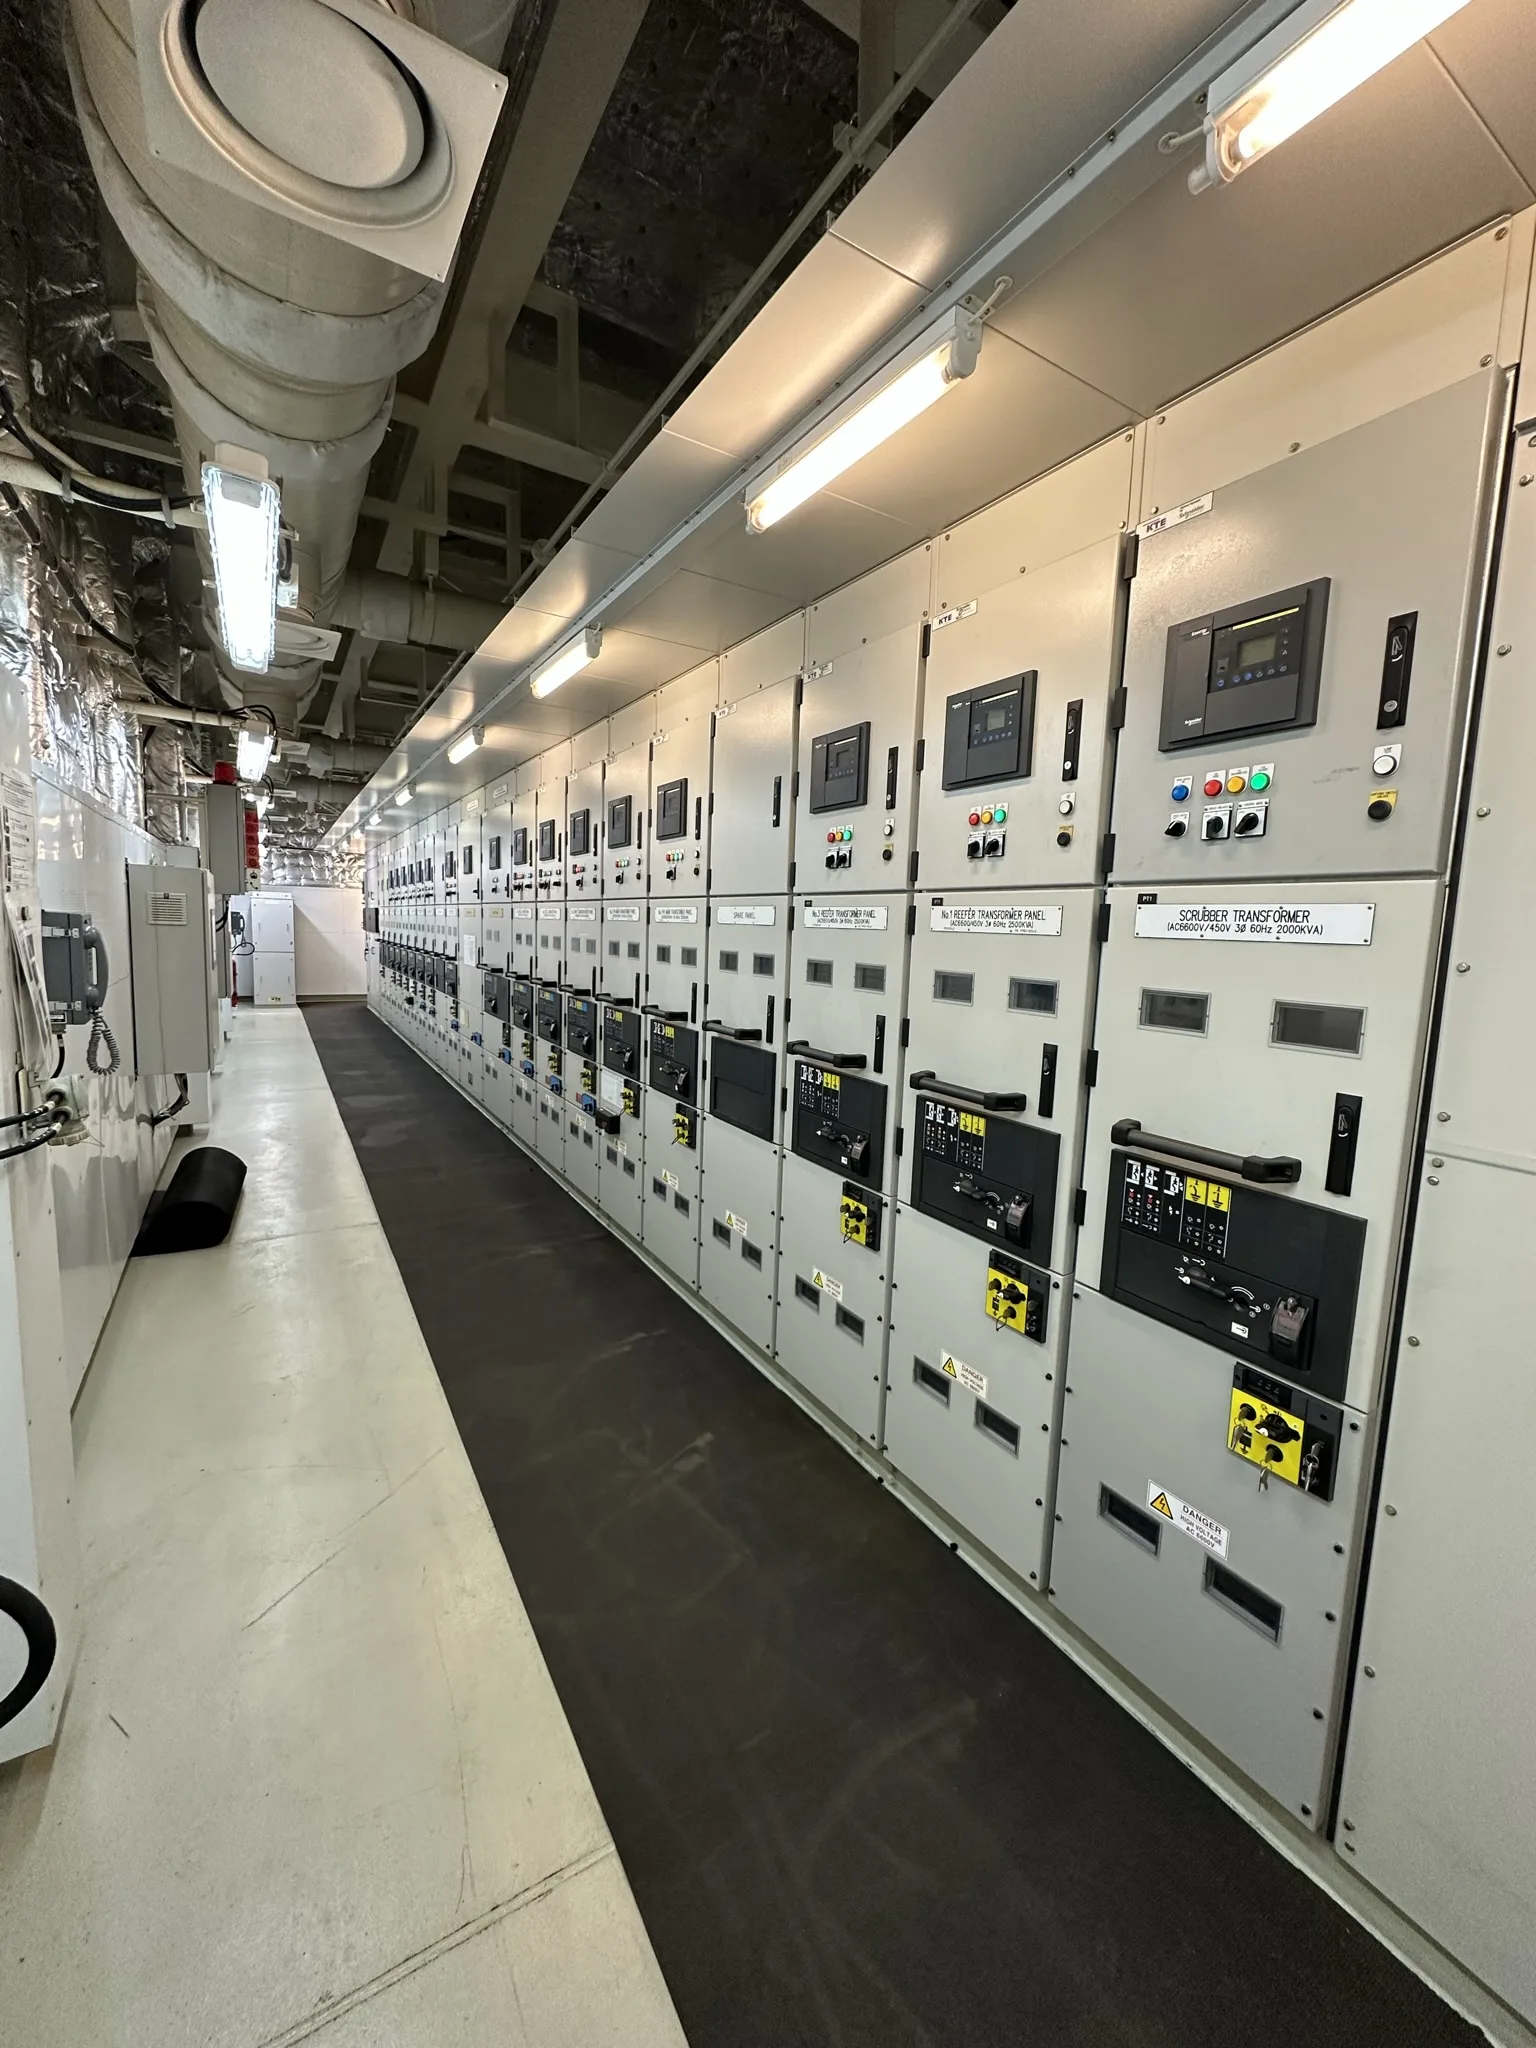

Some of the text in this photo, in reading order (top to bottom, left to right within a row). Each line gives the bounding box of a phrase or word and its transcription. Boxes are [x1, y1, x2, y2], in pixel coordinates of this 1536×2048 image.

[1146, 517, 1167, 533] KTE
[938, 613, 953, 625] KTE
[863, 909, 876, 919] PANEL
[953, 910, 976, 920] REEFER
[978, 910, 1023, 920] TRANSFORMER
[1024, 910, 1046, 921] PANEL
[1179, 909, 1311, 924] SCRUBBER TRANSFORMER
[993, 920, 1006, 928] 60Hz
[1167, 923, 1231, 933] (AC6600V/450V
[1249, 924, 1272, 934] 60Hz
[1276, 925, 1323, 935] 2000KVA)
[961, 1364, 984, 1382] DANGER
[1182, 1504, 1222, 1535] DANGER
[1180, 1514, 1222, 1546] HIGH VOLTAGE
[1186, 1526, 1215, 1548] AC 6600V
